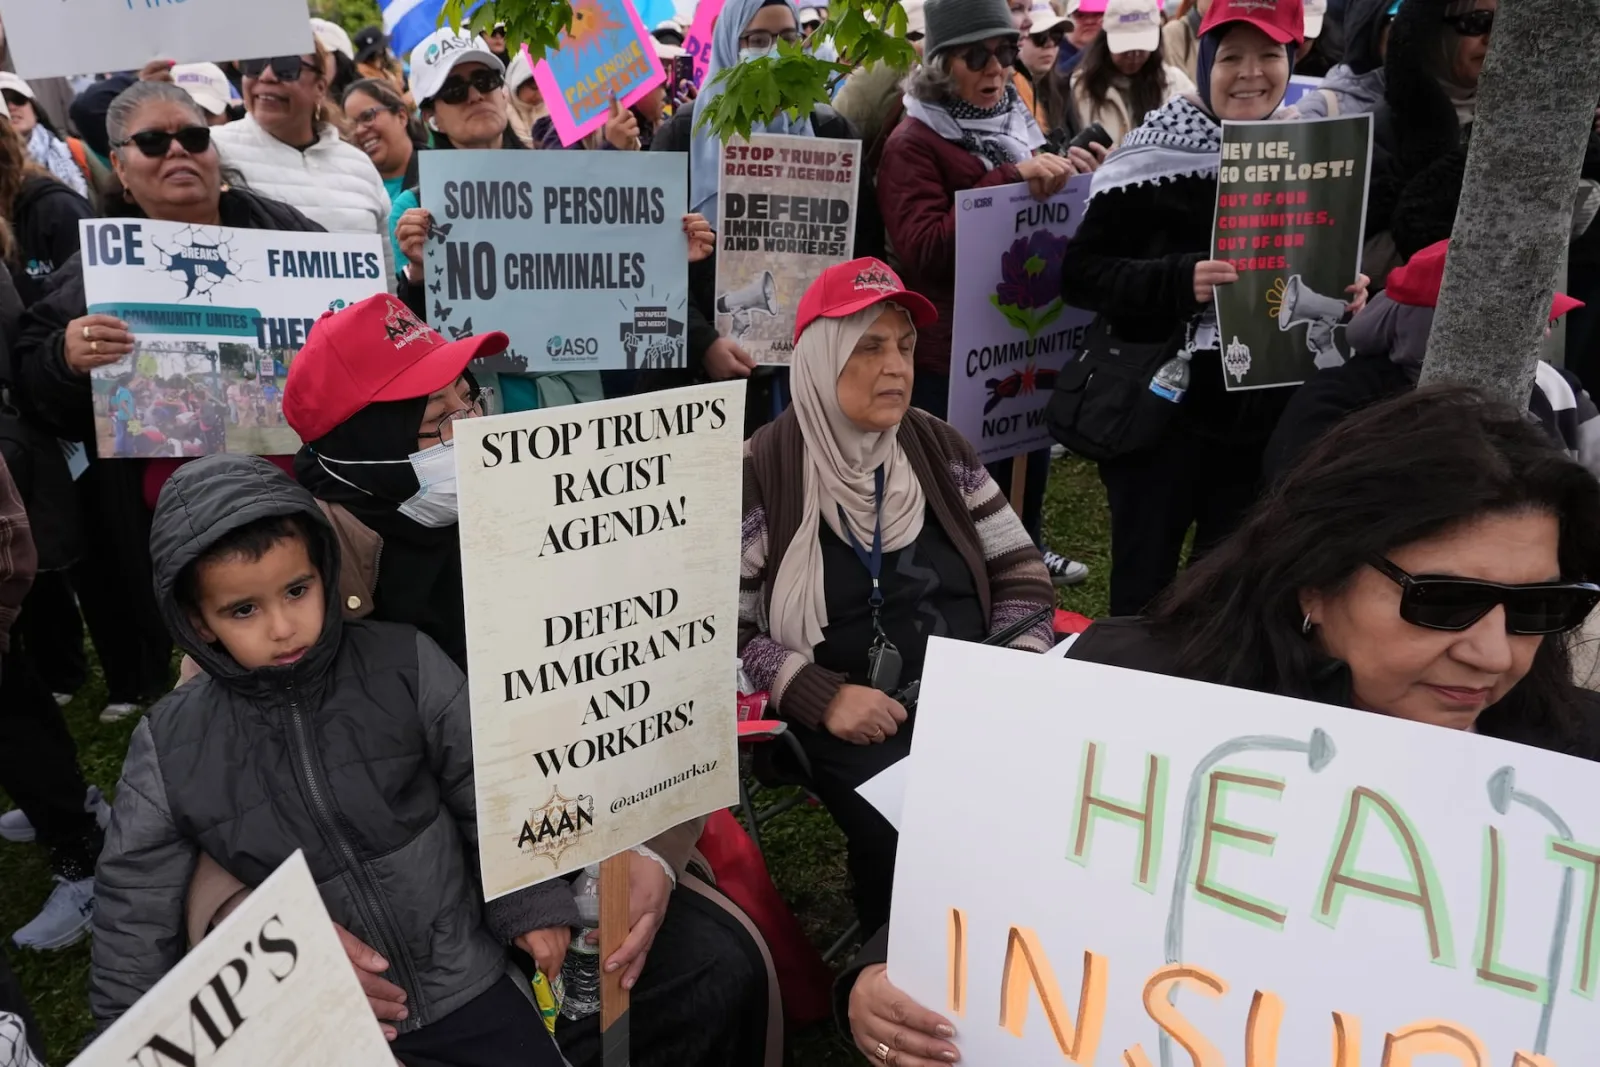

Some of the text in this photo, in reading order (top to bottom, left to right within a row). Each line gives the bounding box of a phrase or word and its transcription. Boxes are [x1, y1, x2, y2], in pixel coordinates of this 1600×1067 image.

[725, 146, 853, 168] STOP TRUMP'S
[1222, 141, 1296, 161] HEY ICE,
[725, 163, 852, 183] RACIST AGENDA!
[1220, 160, 1355, 183] GO GET LOST!
[444, 181, 665, 225] SOMOS PERSONAS
[725, 193, 850, 225] DEFEND
[1220, 191, 1309, 208] OUT OF OUR
[724, 220, 847, 242] IMMIGRANTS
[1015, 203, 1070, 233] FUND
[1218, 210, 1336, 228] COMMUNITIES,
[86, 224, 145, 266] ICE
[181, 247, 219, 262] BREAKS
[723, 237, 846, 256] AND WORKERS!
[1217, 233, 1306, 251] OUT OF OUR
[195, 263, 207, 276] UP
[267, 249, 380, 279] FAMILIES
[446, 241, 645, 301] NO CRIMINALES
[1221, 256, 1292, 271] OSQUES.
[123, 310, 200, 328] COMMUNITY
[207, 312, 248, 329] UNITES
[481, 398, 726, 468] STOP TRUMP'S
[982, 408, 1046, 438] NOT W
[552, 453, 672, 507] RACIST
[537, 495, 687, 558] AGENDA!
[542, 587, 679, 648] DEFEND
[501, 614, 716, 703] IMMIGRANTS
[581, 679, 651, 725] AND
[533, 700, 695, 779] WORKERS!
[610, 759, 718, 815] @aaanmarkaz
[517, 804, 593, 849] AAAN
[127, 913, 299, 1067] MP'S
